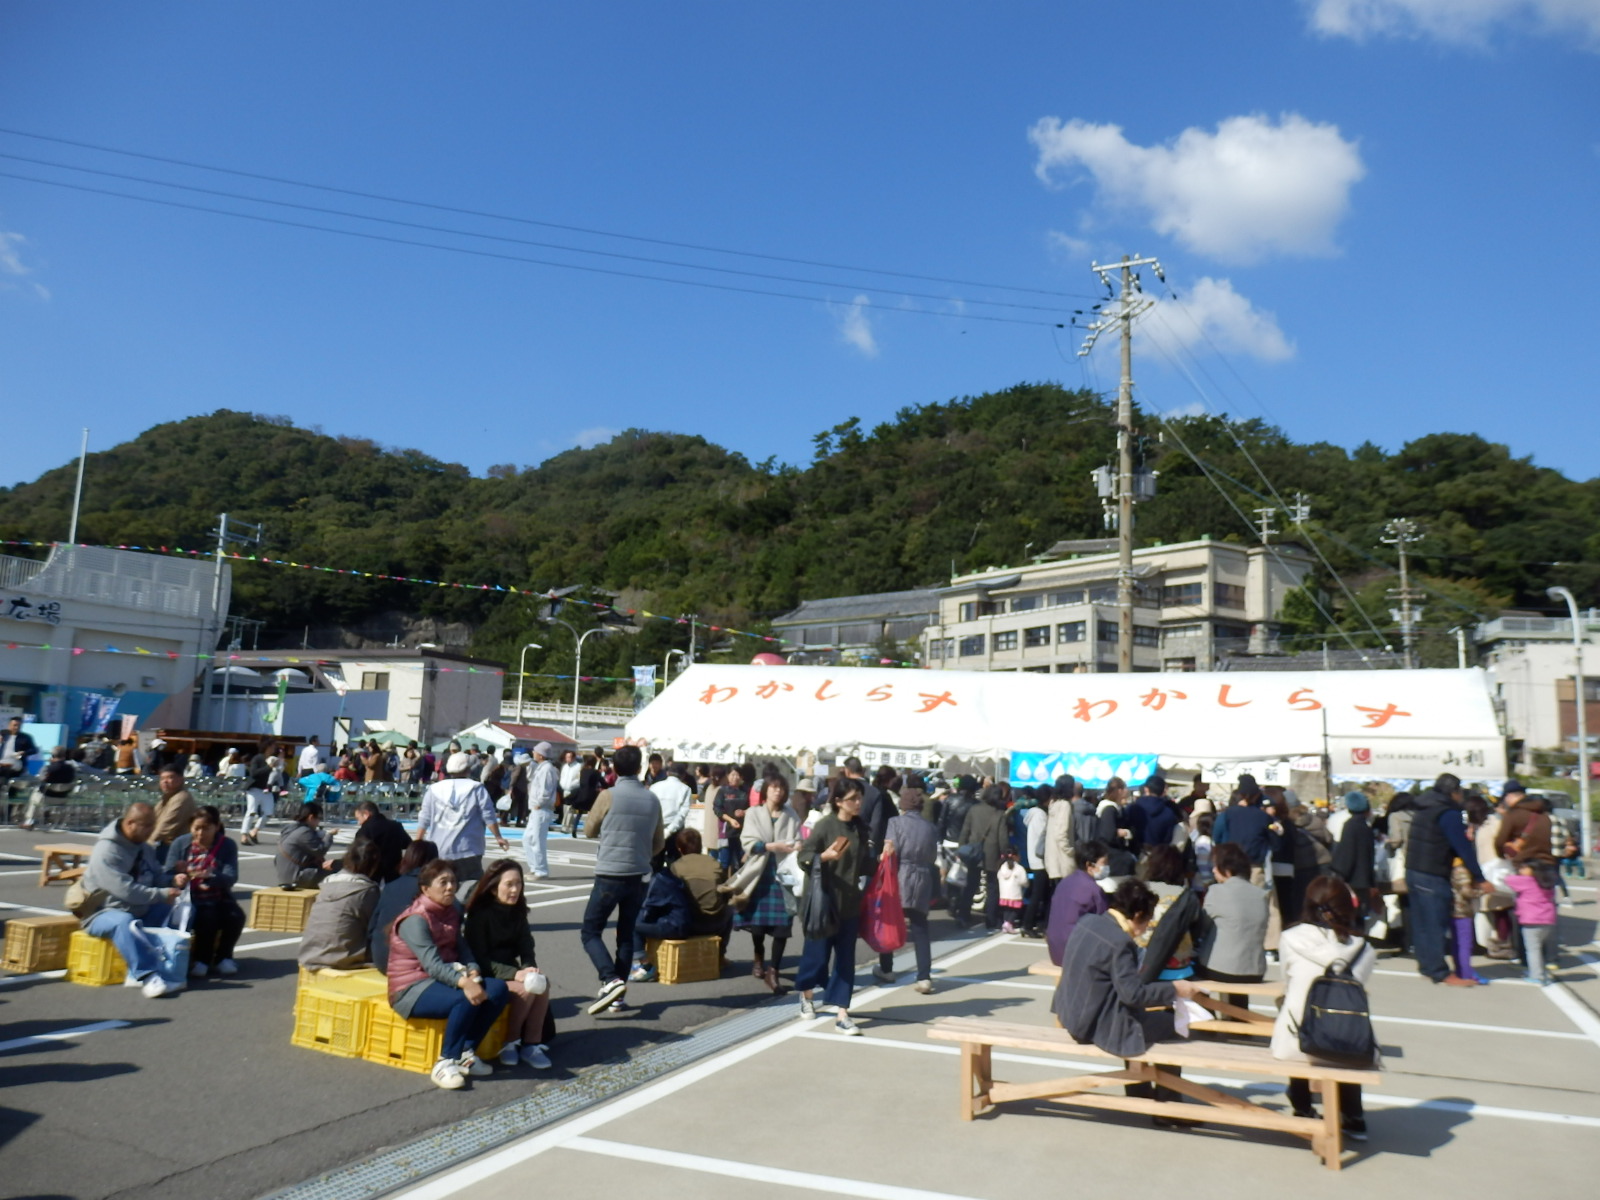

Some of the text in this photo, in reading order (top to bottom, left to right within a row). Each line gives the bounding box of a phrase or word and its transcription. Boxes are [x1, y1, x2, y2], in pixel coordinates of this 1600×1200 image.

[0, 597, 61, 624] 広場
[699, 679, 958, 714] わかしらす
[1072, 684, 1412, 728] わかしらす
